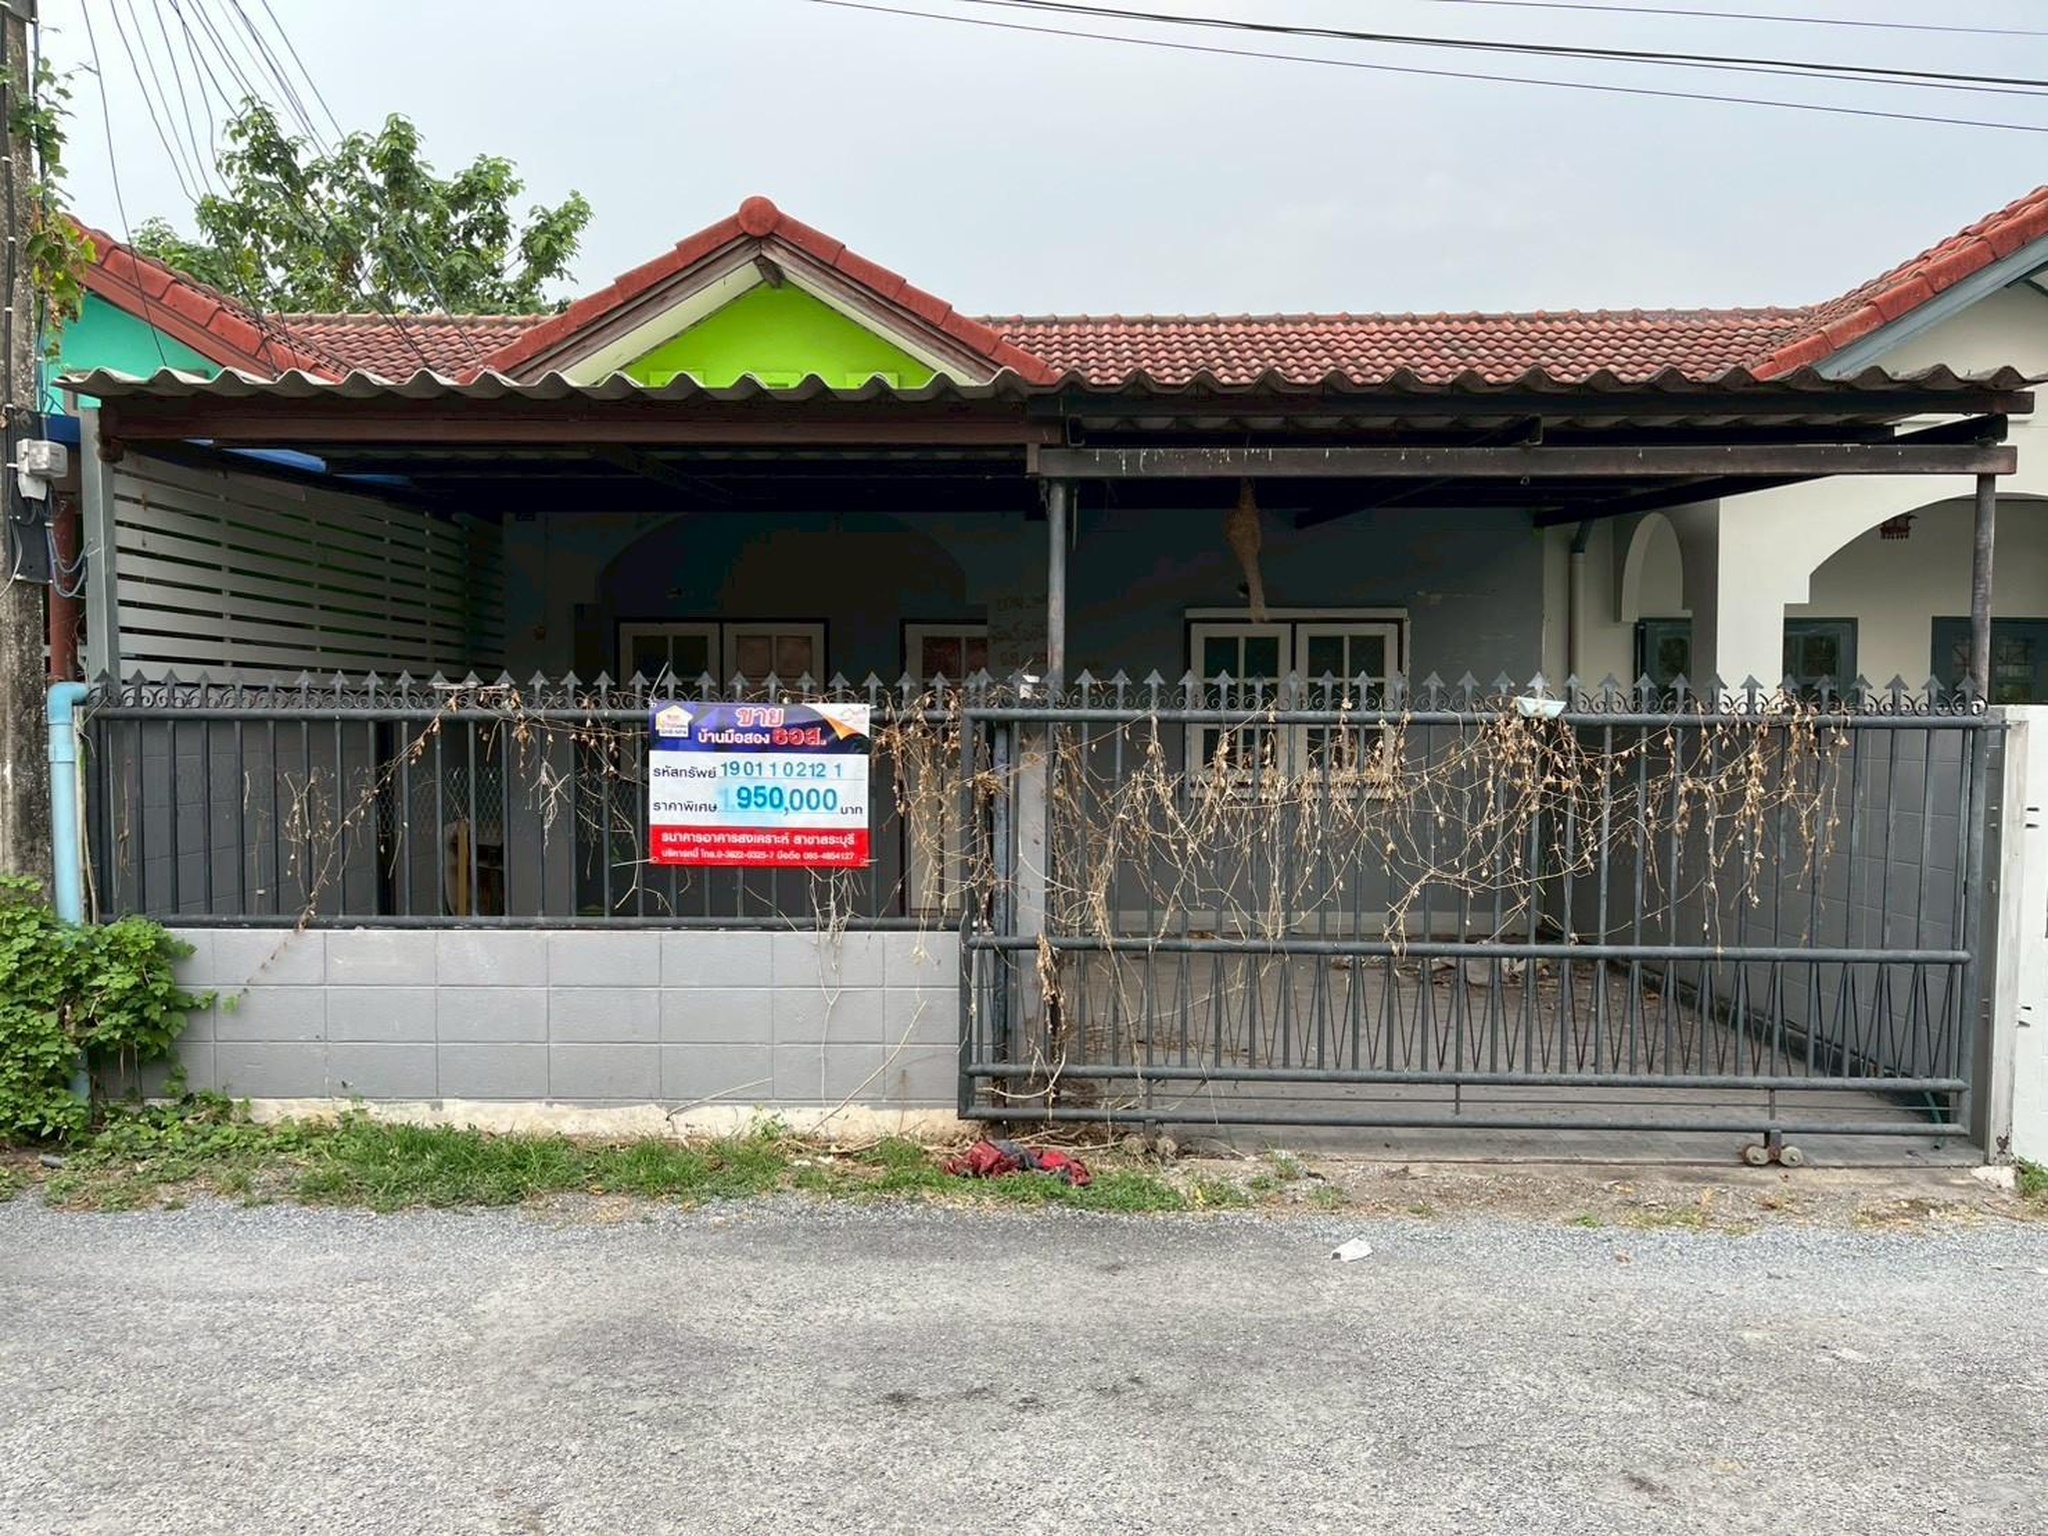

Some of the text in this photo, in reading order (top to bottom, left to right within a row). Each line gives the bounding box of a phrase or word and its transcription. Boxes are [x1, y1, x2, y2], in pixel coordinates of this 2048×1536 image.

[736, 706, 785, 728] ขาย
[698, 728, 771, 745] บ้านมือสอง
[652, 764, 718, 780] รหัสทรัพย์
[652, 800, 718, 813] ราคาพิเศษ
[840, 803, 864, 816] บาท
[661, 831, 856, 849] ธนาคารอาคารสงเคราะห์ สาขาสระบุรี
